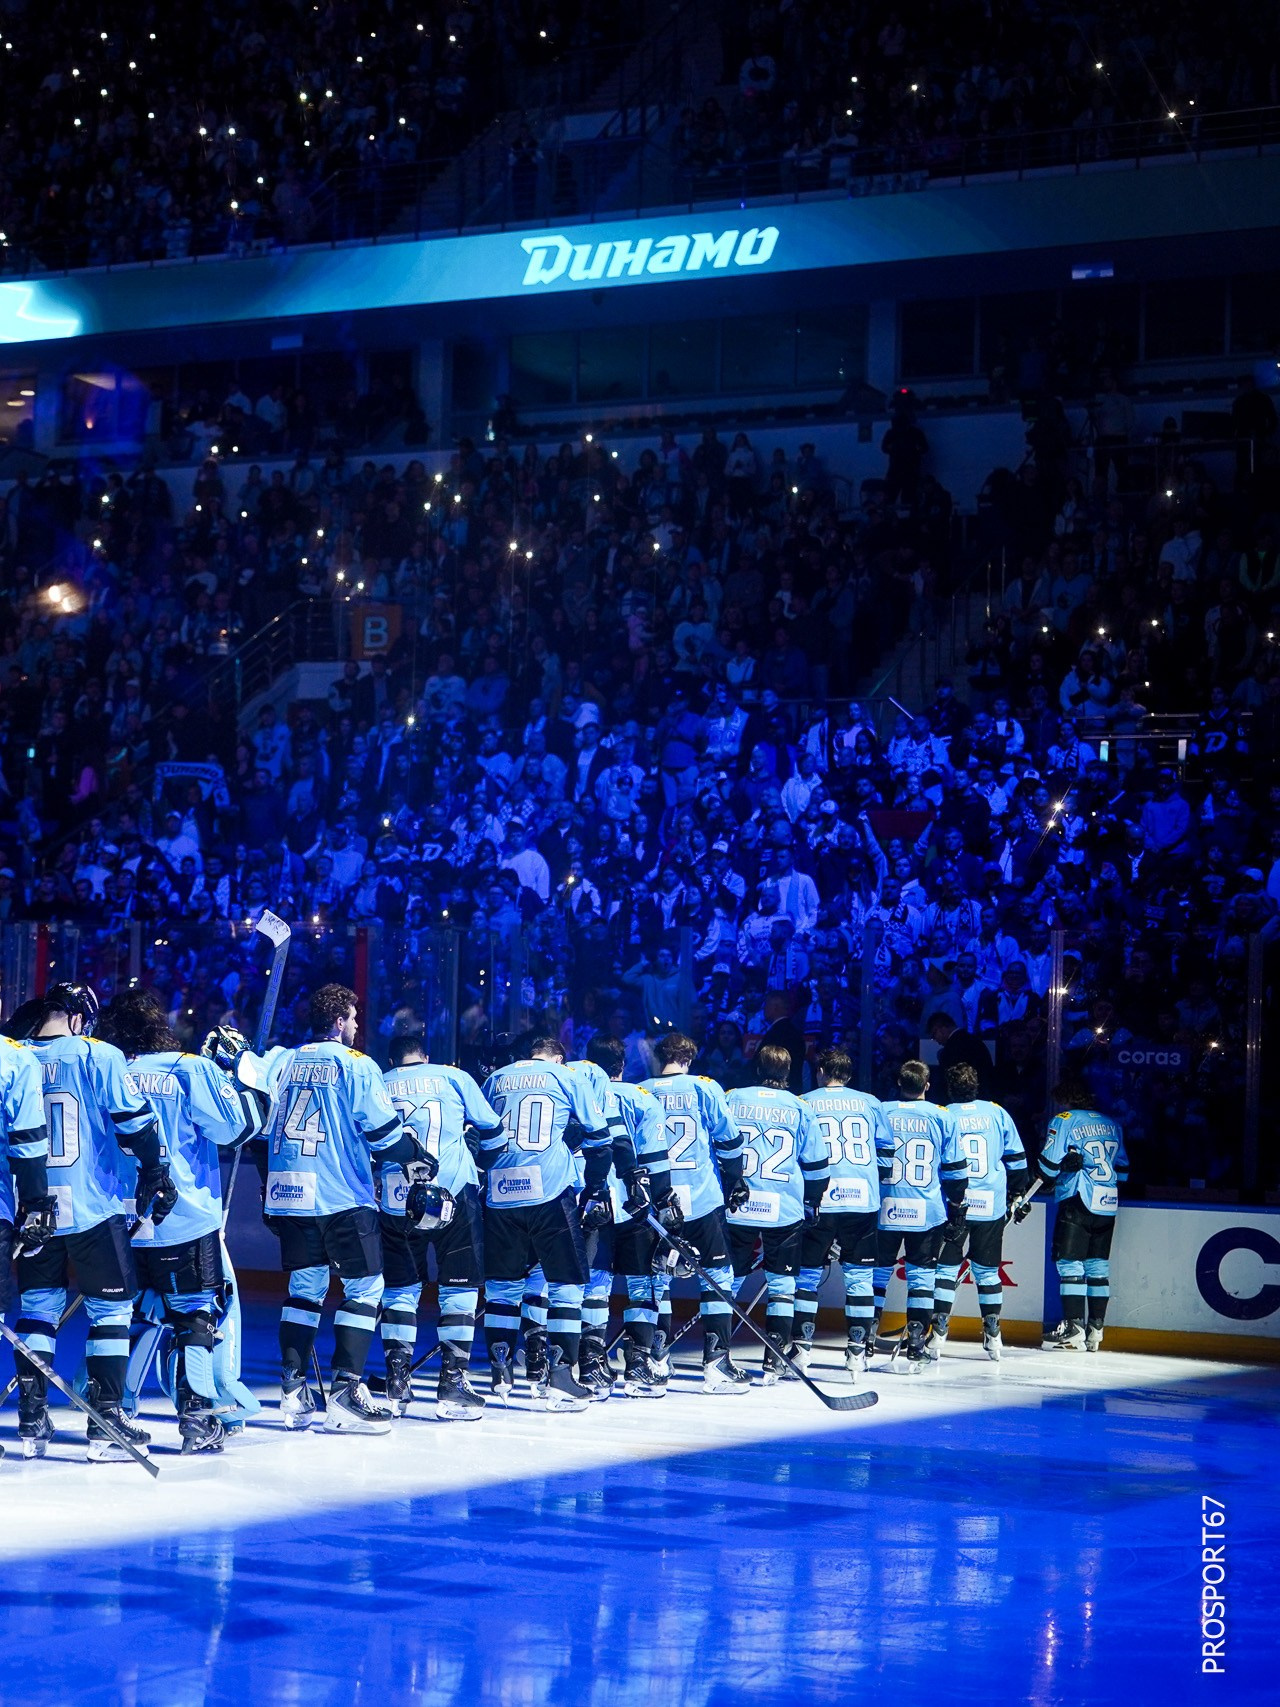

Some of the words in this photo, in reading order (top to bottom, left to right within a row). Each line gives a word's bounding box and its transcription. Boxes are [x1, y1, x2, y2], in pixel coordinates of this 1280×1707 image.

[495, 1073, 548, 1094] KALININ
[273, 1088, 327, 1158] 14
[1072, 1123, 1116, 1141] CHUKHRAY
[1082, 1140, 1119, 1183] 37
